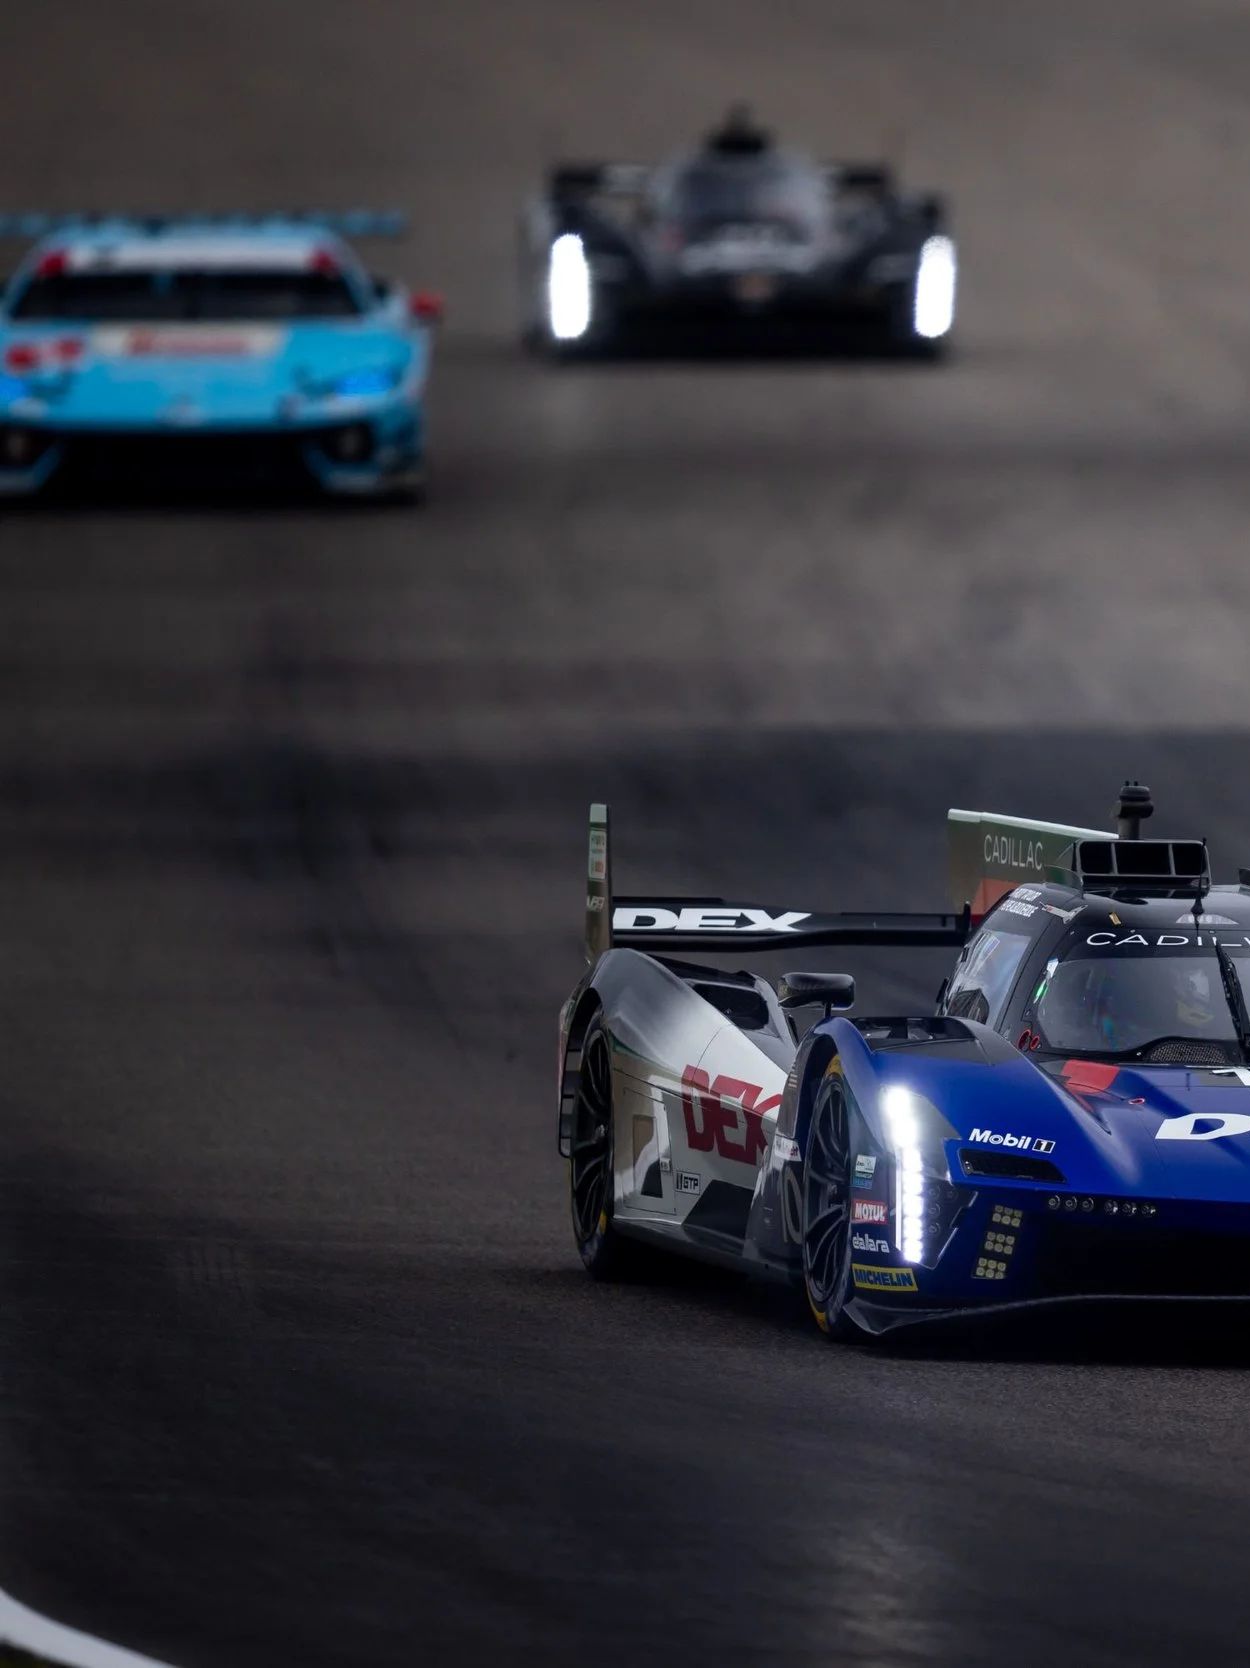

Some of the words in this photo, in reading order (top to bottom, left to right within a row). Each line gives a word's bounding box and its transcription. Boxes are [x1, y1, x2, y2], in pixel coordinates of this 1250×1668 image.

[984, 834, 1043, 870] CADILLAC
[613, 907, 812, 932] DEX
[681, 1064, 785, 1166] DEX
[968, 1128, 1032, 1149] Mobil
[683, 1176, 699, 1190] GTP
[854, 1202, 886, 1221] MOTUL
[853, 1268, 914, 1287] MICHELIN
